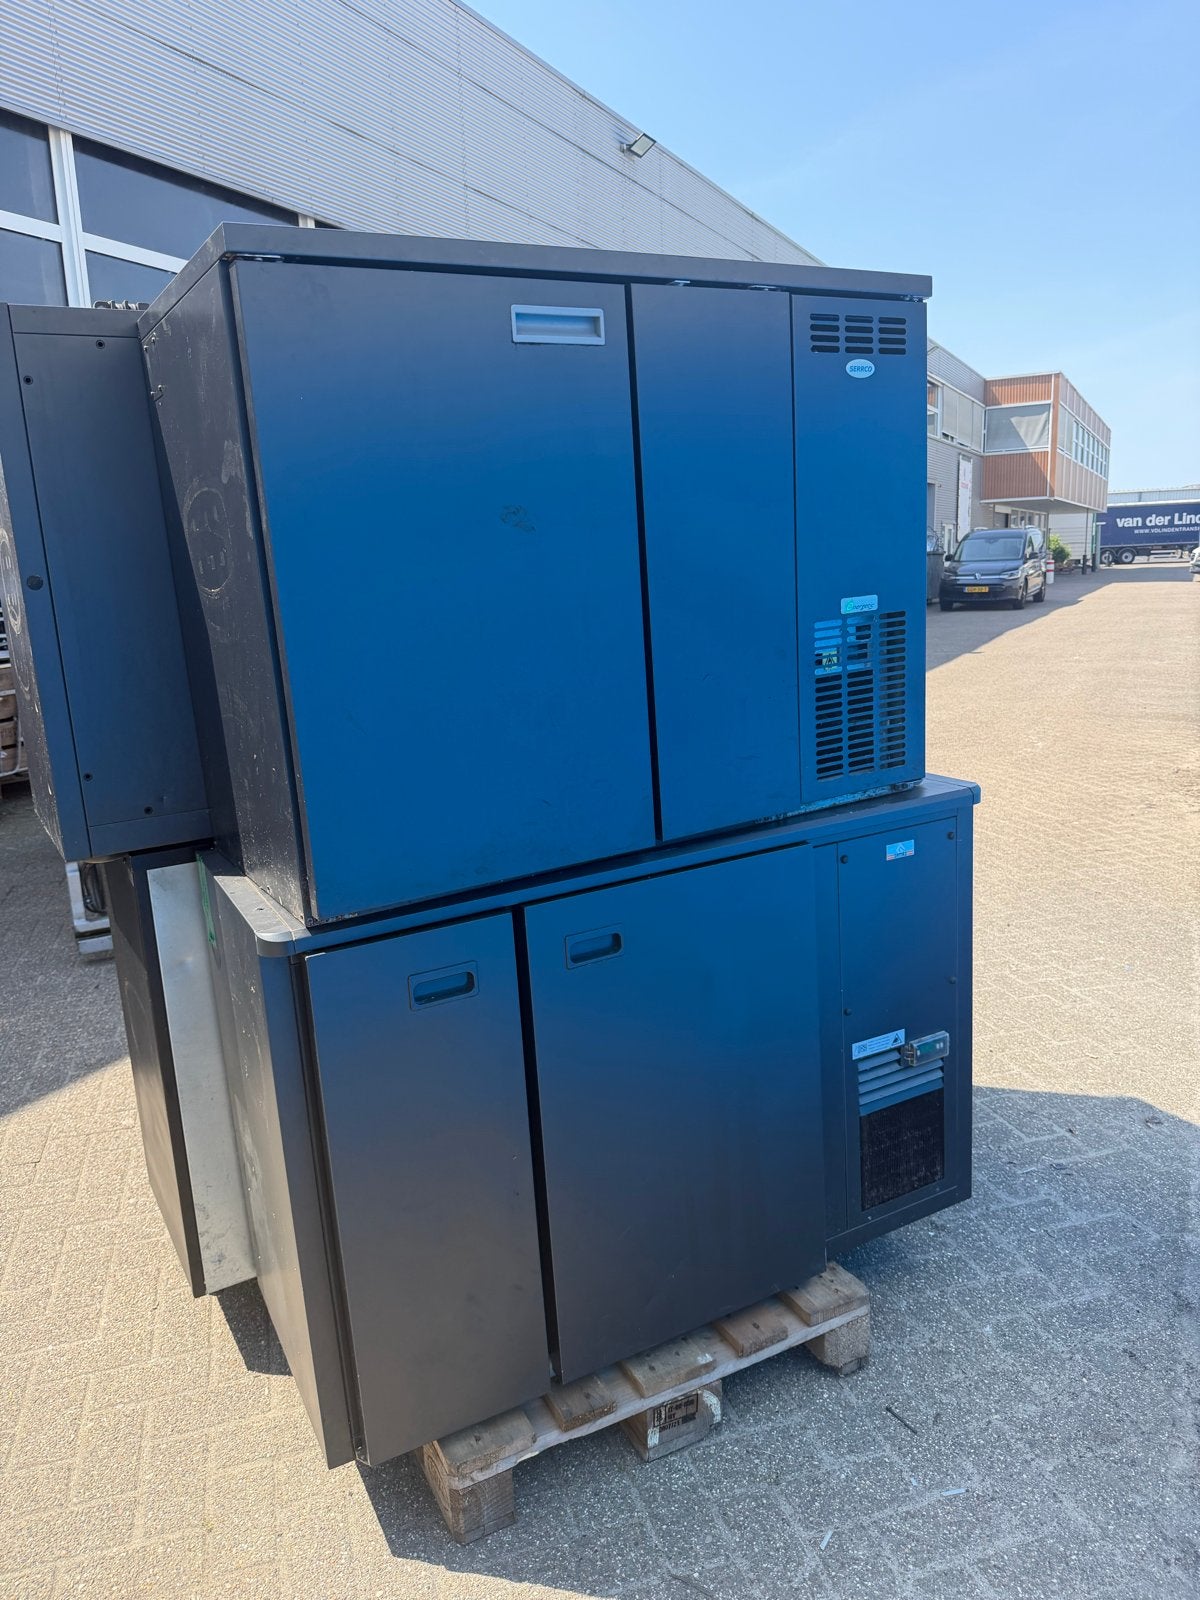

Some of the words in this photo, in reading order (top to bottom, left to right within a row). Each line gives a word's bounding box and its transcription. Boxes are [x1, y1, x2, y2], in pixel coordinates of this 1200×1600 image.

[849, 365, 873, 373] SERRCO
[1116, 517, 1142, 527] van
[1145, 514, 1171, 526] der
